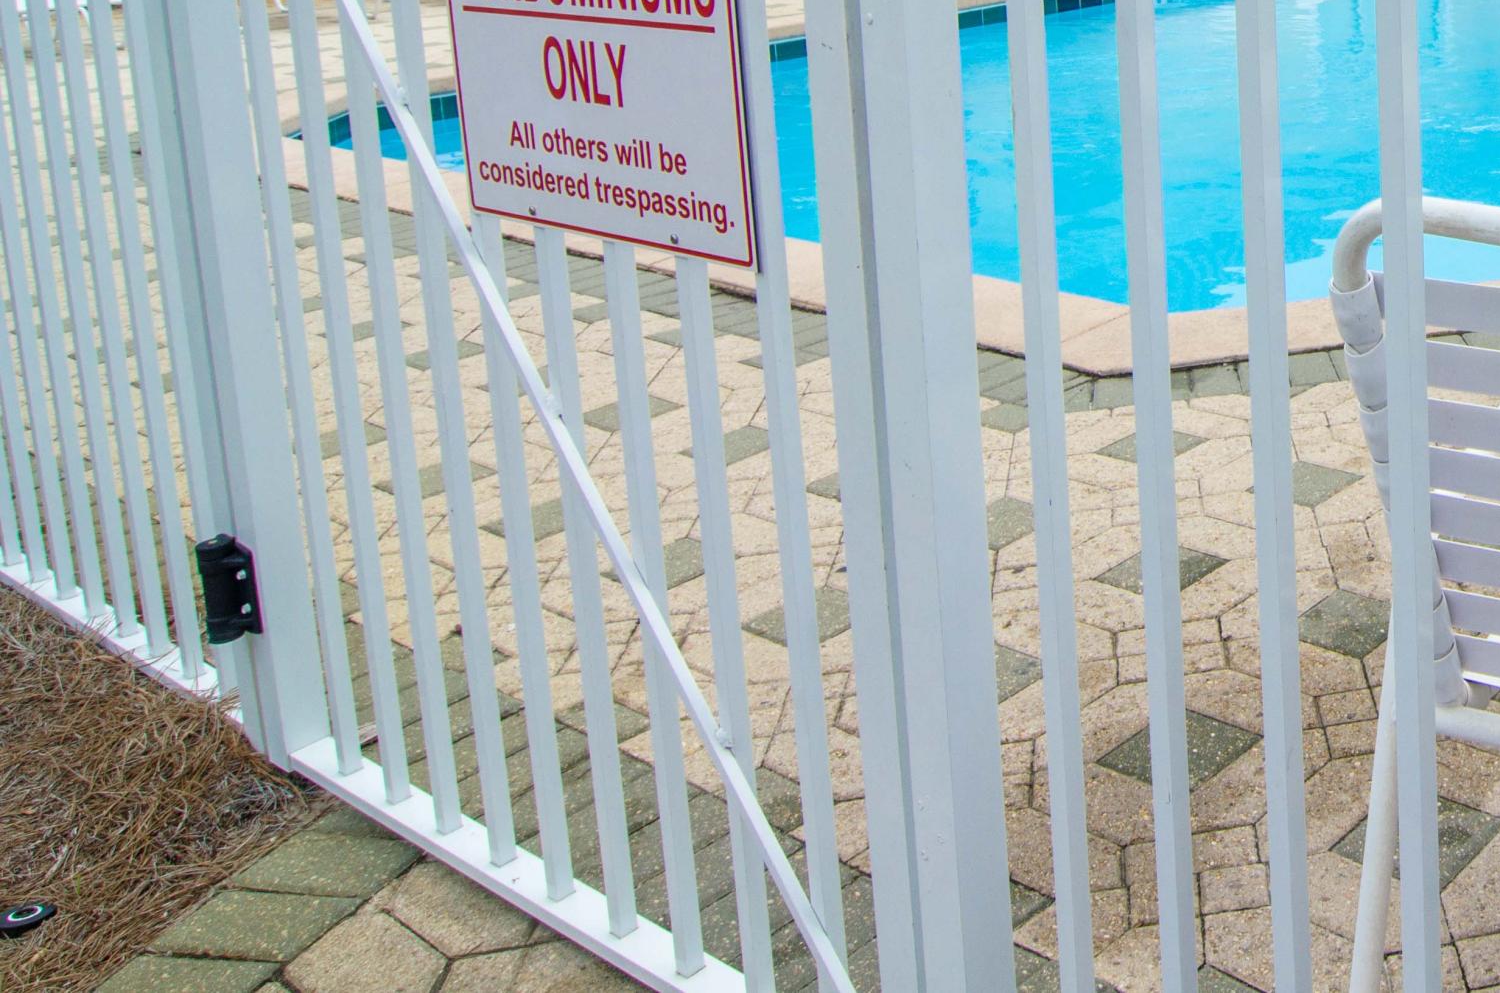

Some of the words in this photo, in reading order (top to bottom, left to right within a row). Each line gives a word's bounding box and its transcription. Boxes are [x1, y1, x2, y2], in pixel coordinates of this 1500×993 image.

[543, 35, 627, 109] ONLY
[510, 120, 537, 150] All
[542, 128, 610, 163] others
[615, 139, 653, 170] will
[658, 143, 688, 175] be
[479, 160, 591, 200] considered
[595, 176, 736, 234] trespassing.
